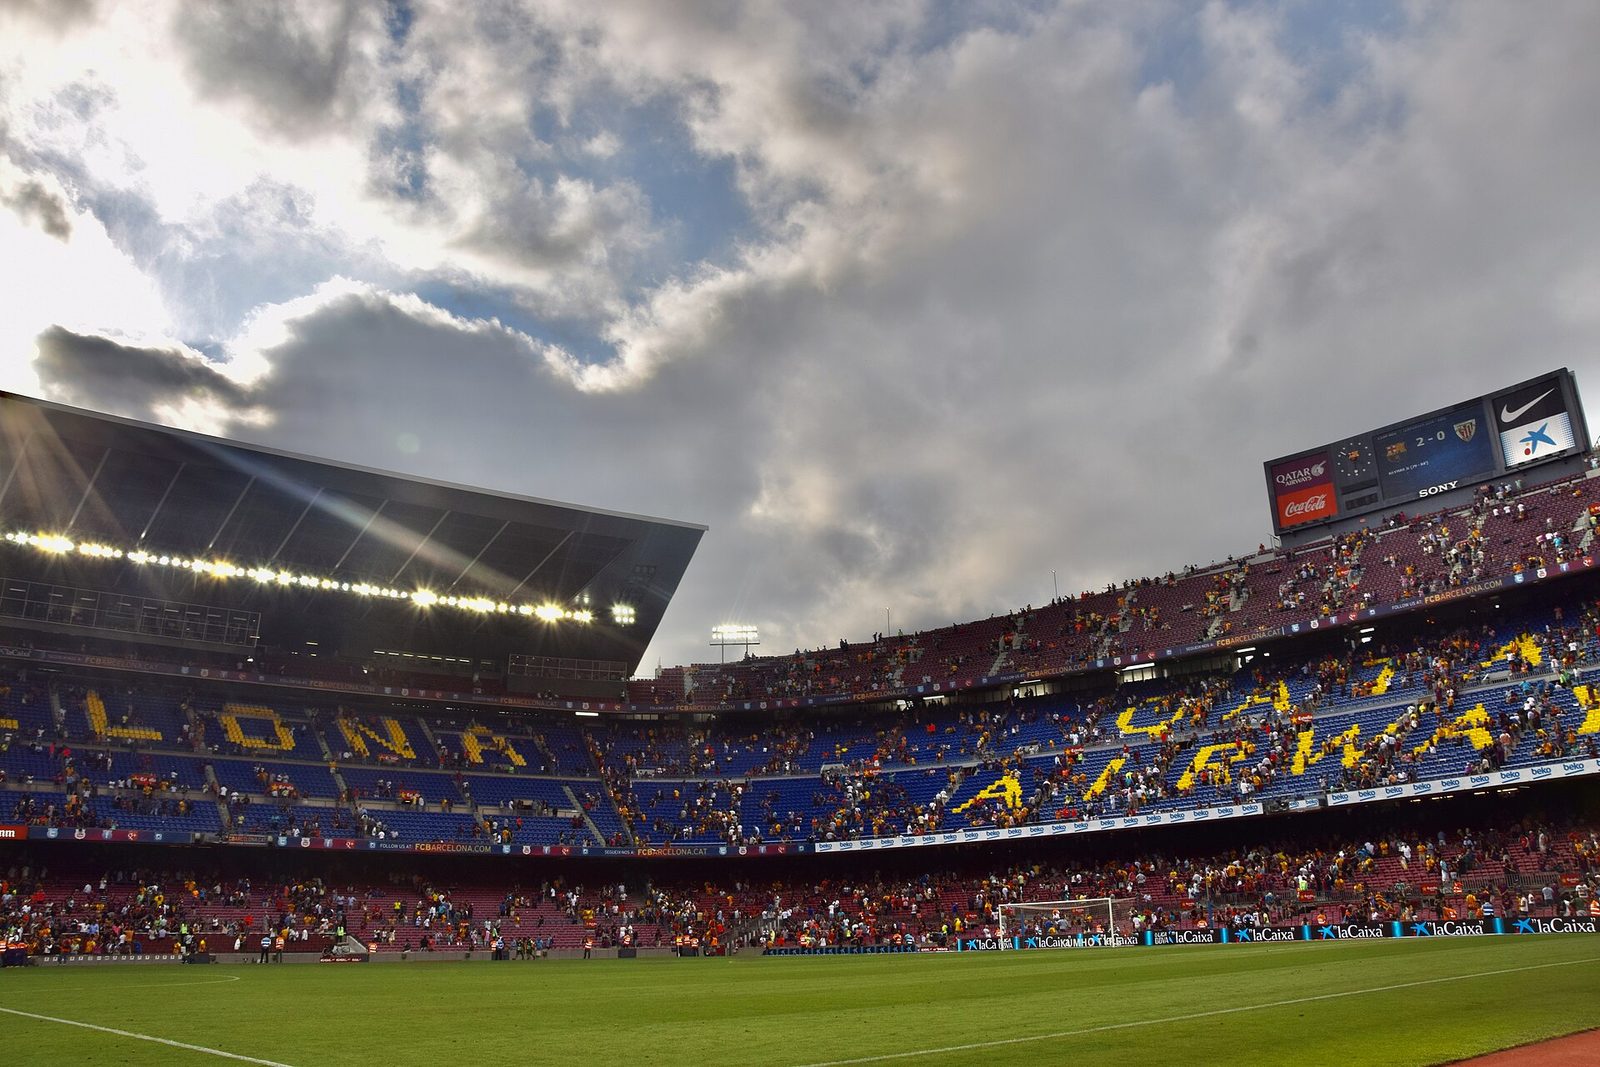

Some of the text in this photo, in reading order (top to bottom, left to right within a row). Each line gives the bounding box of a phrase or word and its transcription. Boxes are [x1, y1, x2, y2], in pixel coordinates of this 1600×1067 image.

[1276, 467, 1311, 484] QATAR
[1419, 481, 1458, 498] SONY
[1424, 579, 1503, 604] FCBARCELONA.COM
[1216, 628, 1281, 647] FCBARCELONA.CAT
[1331, 762, 1584, 801] beko beko beko beko beko beko beko beko beko
[1100, 819, 1116, 827] beko
[1123, 817, 1138, 825] beko
[1170, 812, 1185, 820] beko
[1193, 809, 1209, 818] beko
[1217, 807, 1234, 815] beko
[1242, 804, 1259, 813] beko
[414, 842, 492, 853] FCBARCELONA.COM
[637, 847, 708, 856] FCBARCELONA.CAT
